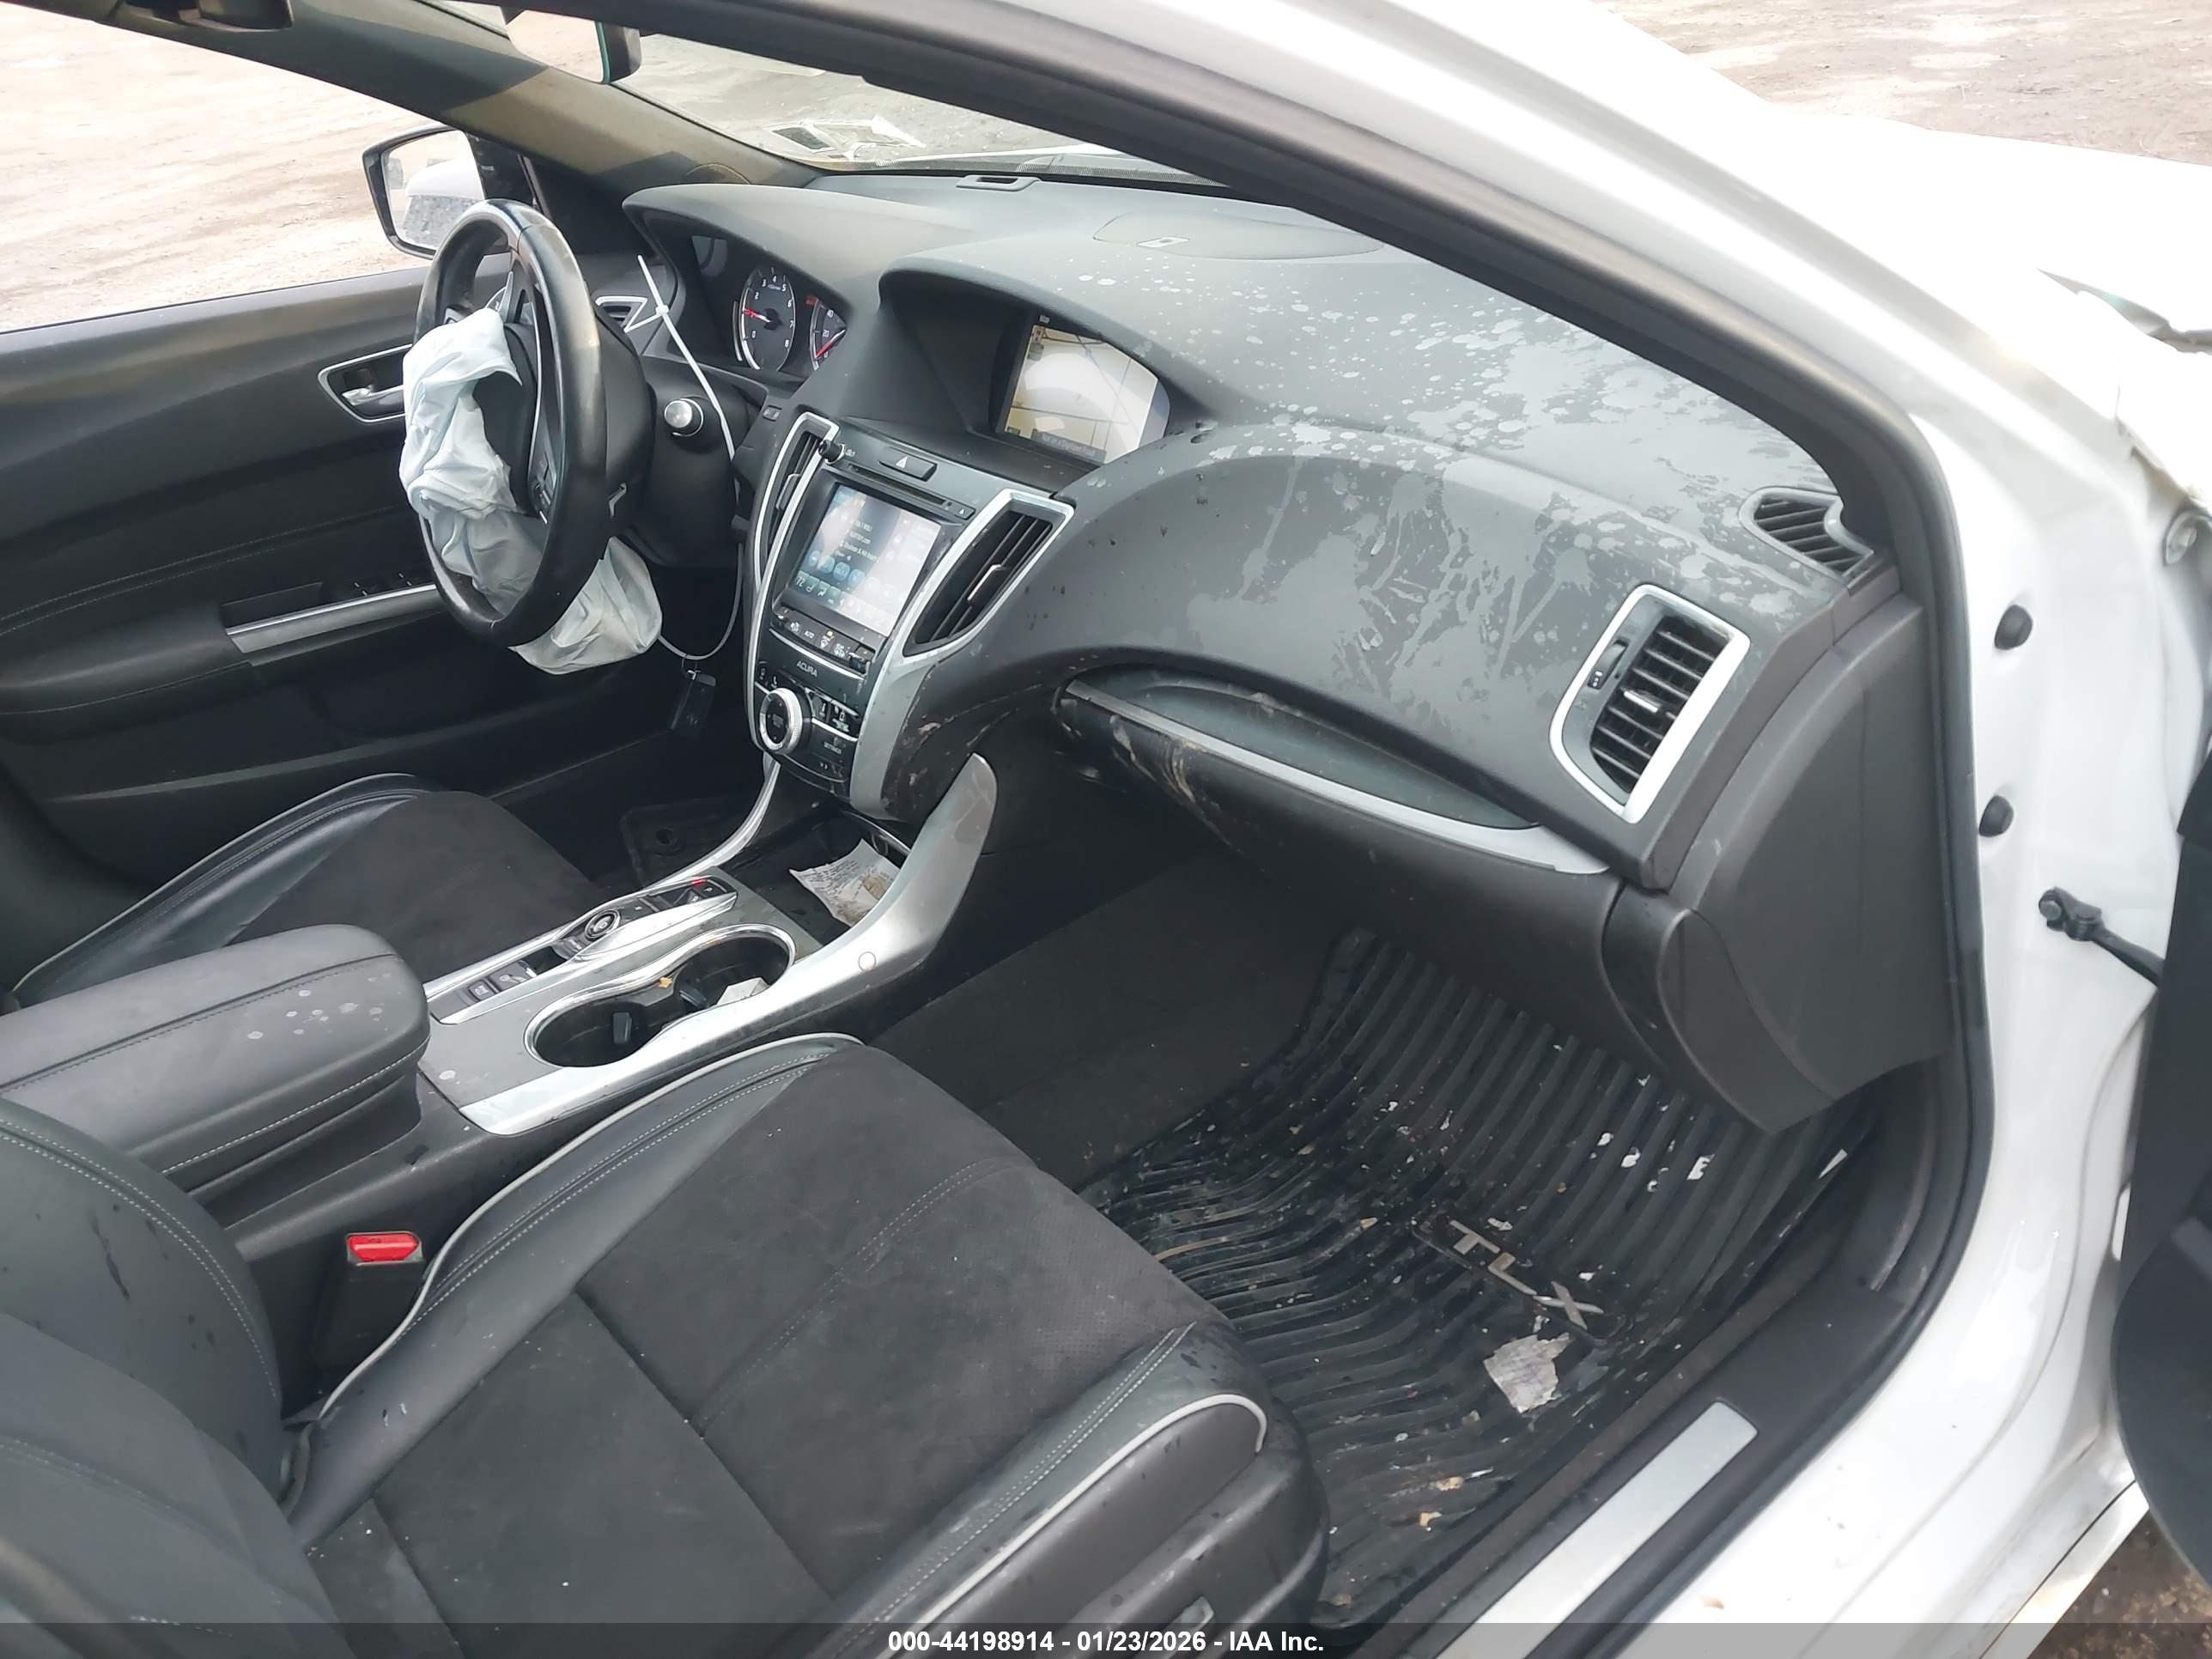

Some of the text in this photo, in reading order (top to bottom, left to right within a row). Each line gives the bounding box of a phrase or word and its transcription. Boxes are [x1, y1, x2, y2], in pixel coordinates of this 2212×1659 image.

[781, 283, 787, 292] 5
[754, 291, 760, 300] 2
[796, 660, 818, 678] ACURA
[1449, 1219, 1604, 1331] TLX
